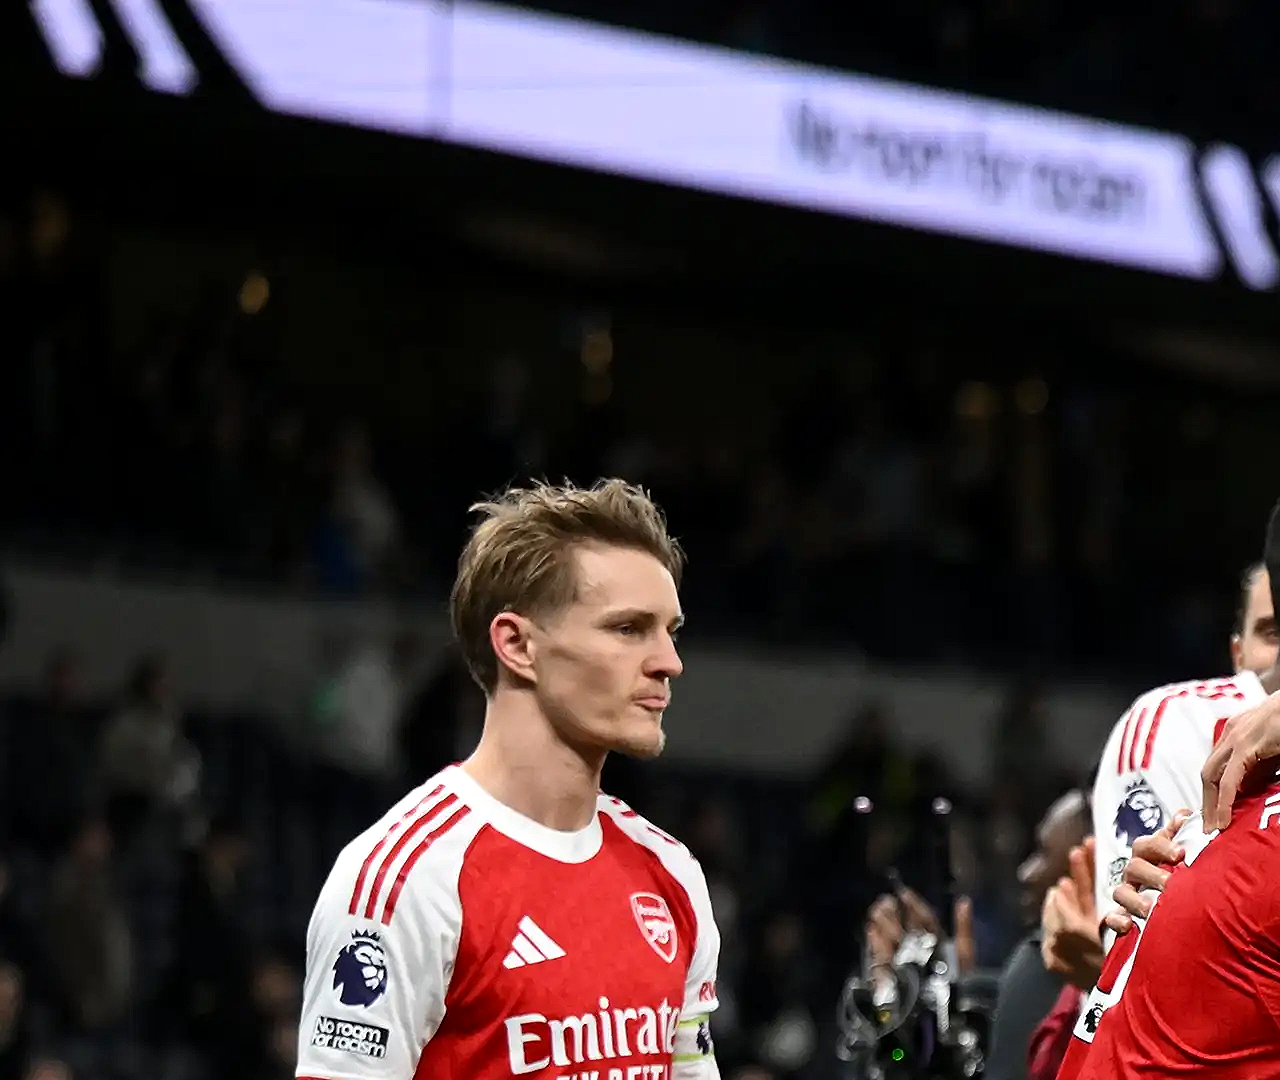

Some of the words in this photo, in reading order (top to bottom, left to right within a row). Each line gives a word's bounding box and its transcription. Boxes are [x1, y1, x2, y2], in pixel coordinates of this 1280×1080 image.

[314, 1017, 335, 1035] No
[336, 1021, 381, 1043] room
[504, 996, 680, 1076] Emirate
[333, 1035, 386, 1060] racism
